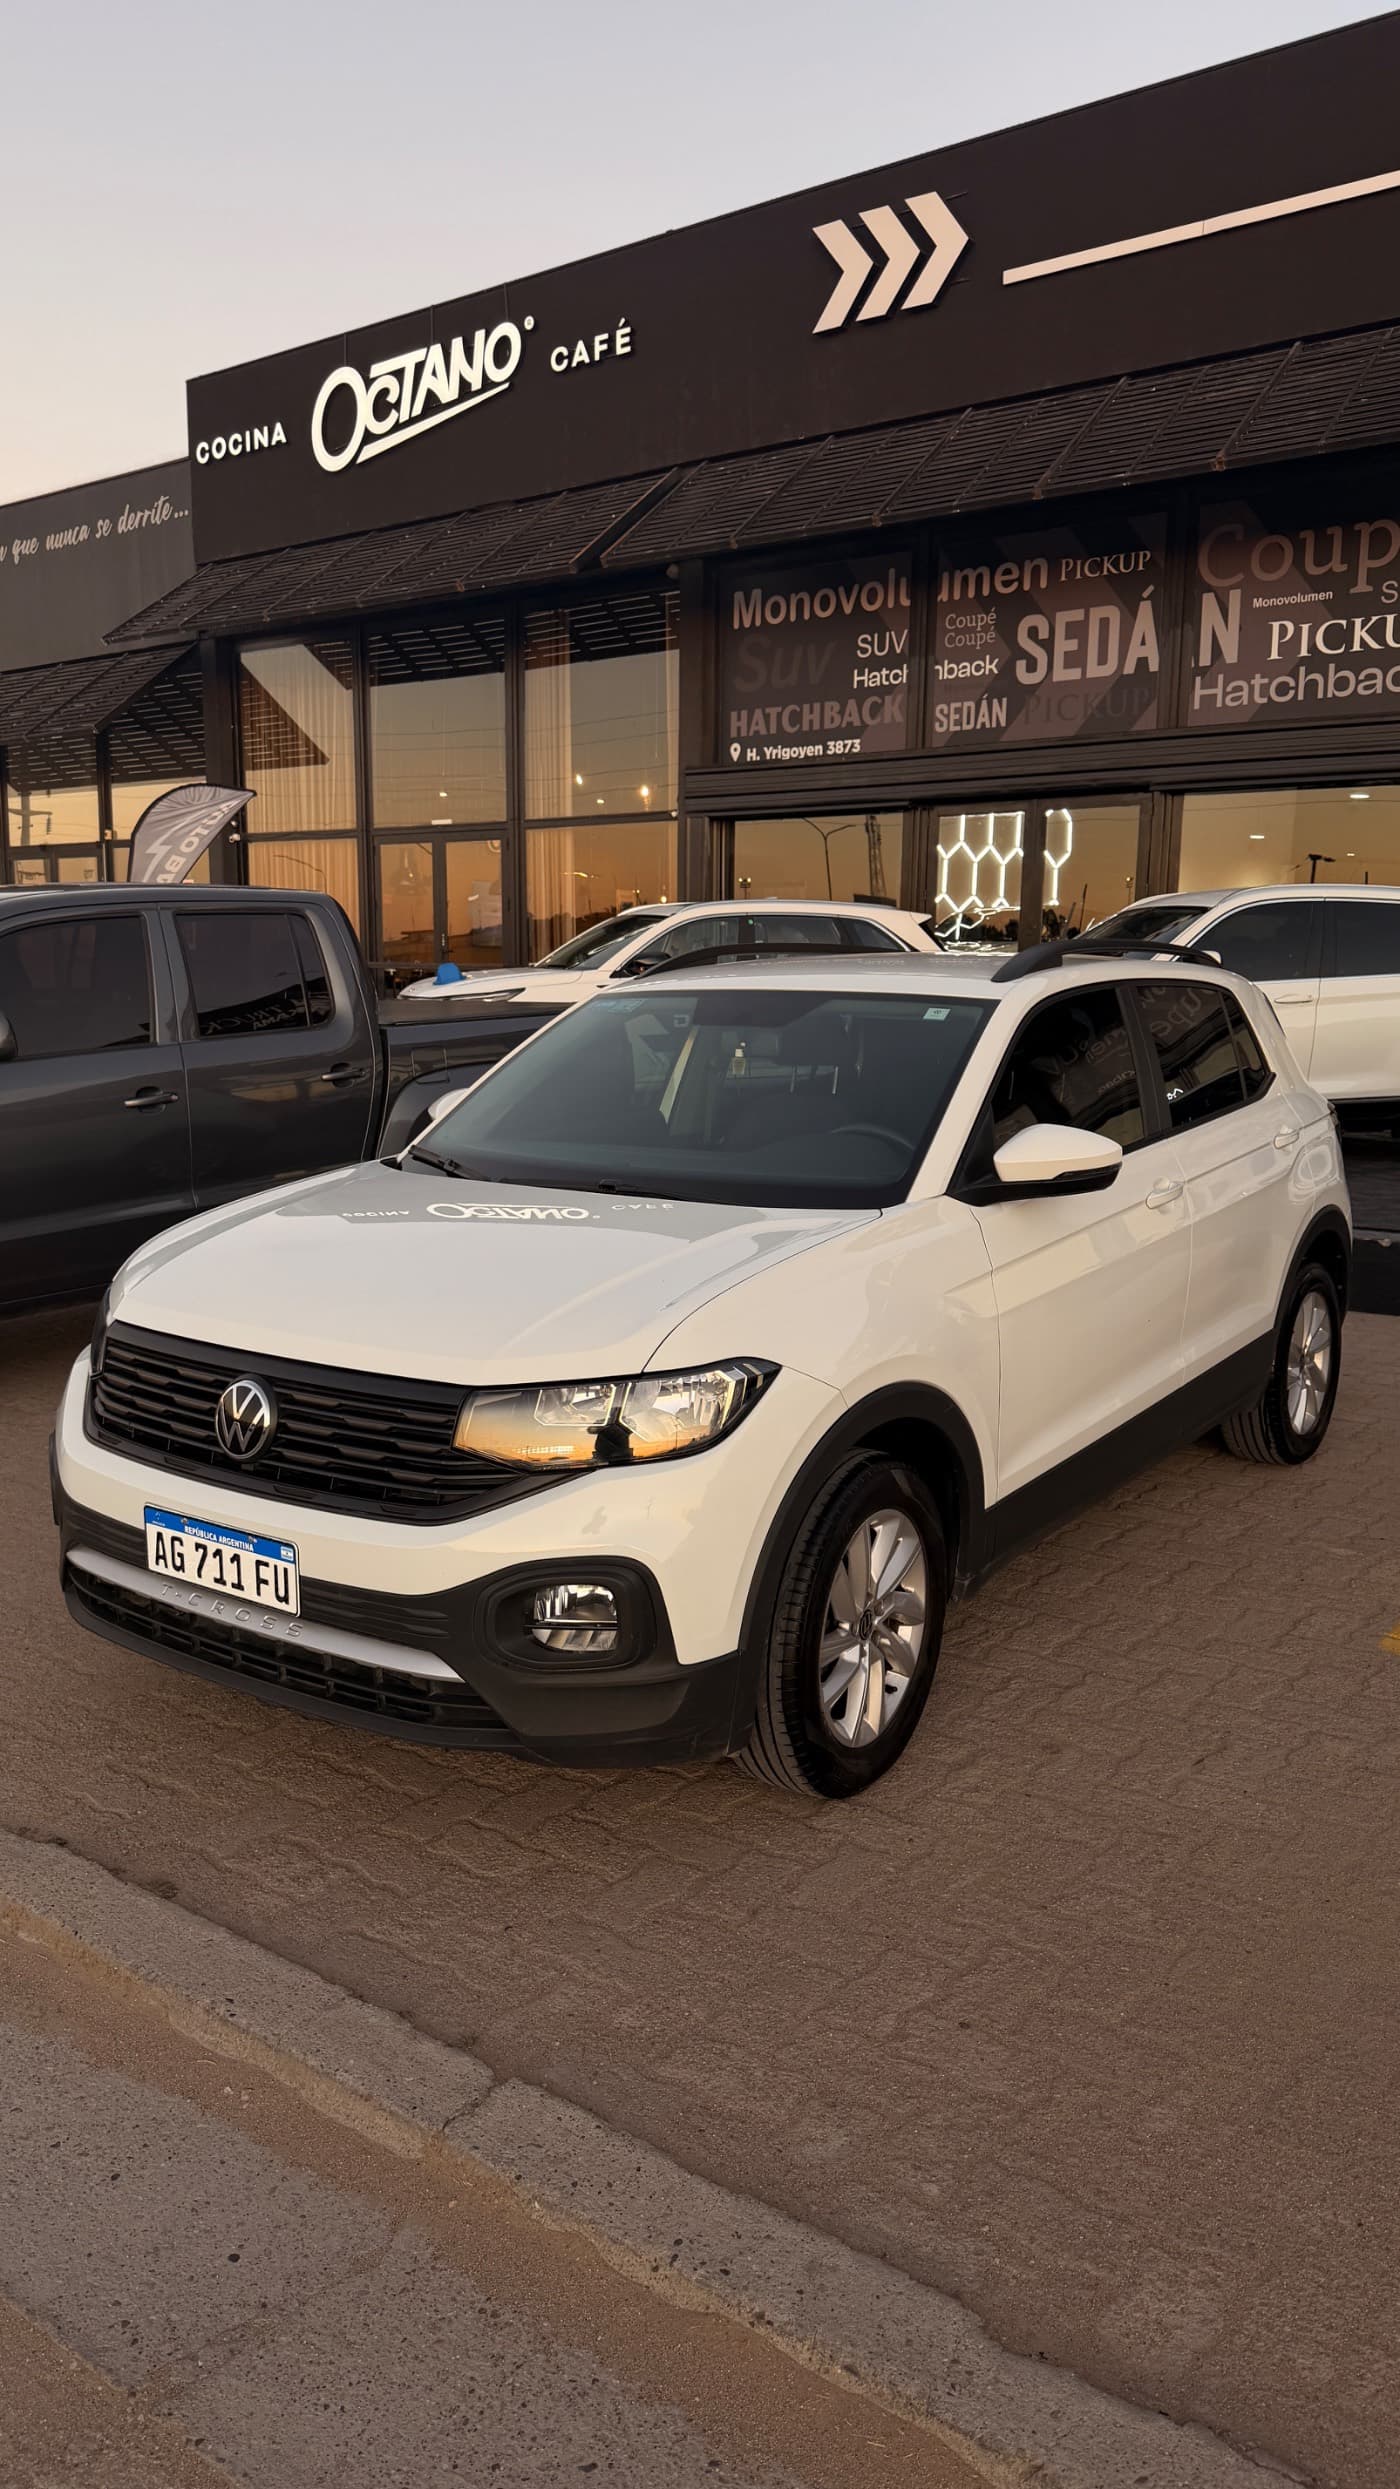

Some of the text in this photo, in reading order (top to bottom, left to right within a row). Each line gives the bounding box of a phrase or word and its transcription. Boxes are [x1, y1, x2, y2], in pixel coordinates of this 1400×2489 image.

[195, 318, 632, 472] COCINA OCTANO CAFÉ
[12, 537, 40, 565] que
[46, 525, 91, 551] nunca
[95, 518, 113, 539] se
[1060, 550, 1152, 582] PICKUP
[1252, 590, 1334, 609] Monovolumen
[945, 607, 997, 631] Coupé
[856, 629, 908, 659] SUV
[944, 626, 996, 649] Coupé
[730, 695, 905, 739] HATCHBACK
[934, 693, 1008, 733] SEDÁN
[746, 738, 861, 762] H. Yrigoyen 3873
[184, 1525, 254, 1553] REPÚBLICA ARGENTINA
[155, 1531, 290, 1605] AG 711 FU
